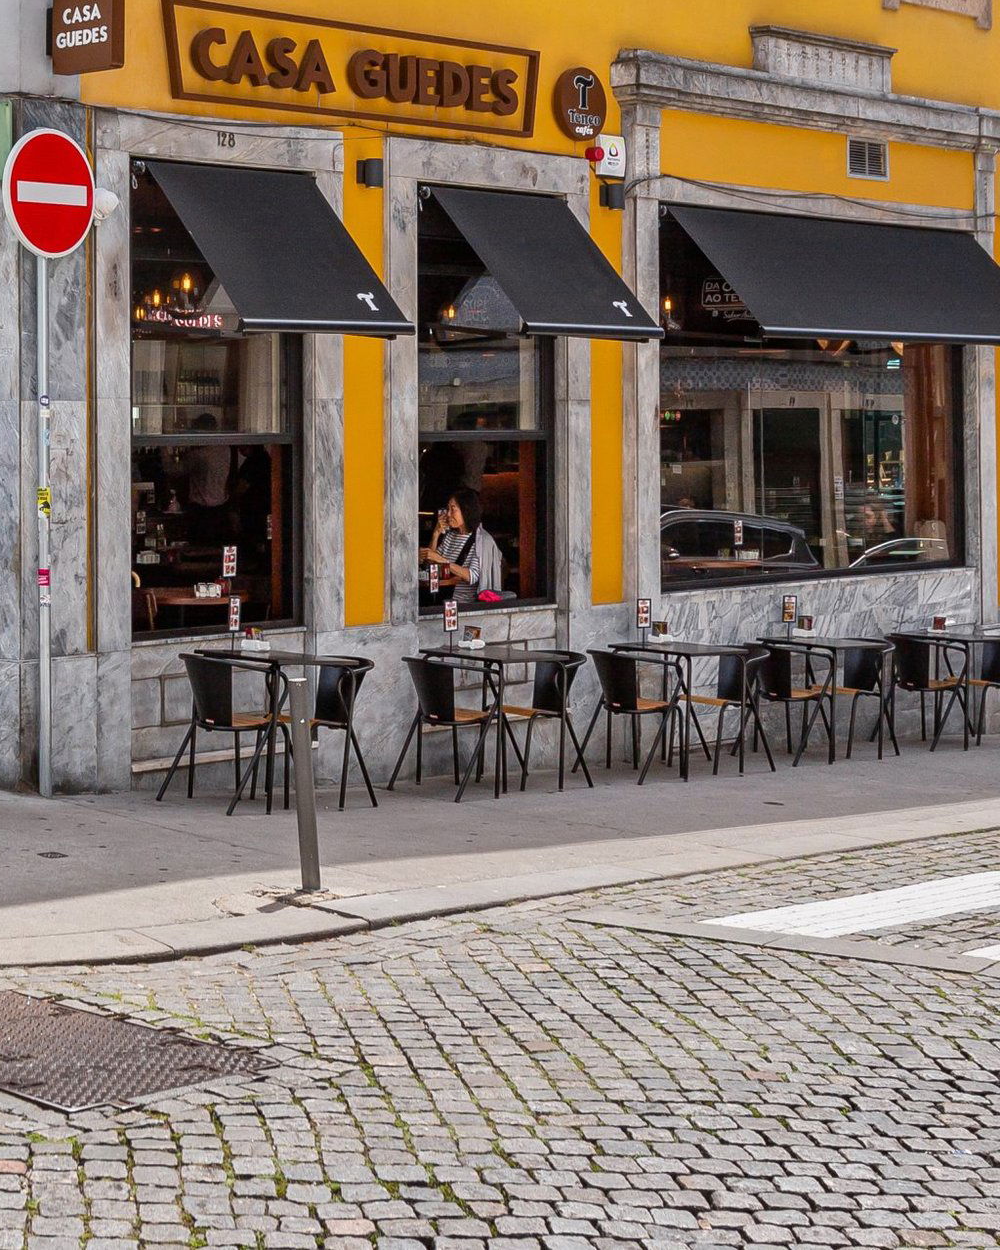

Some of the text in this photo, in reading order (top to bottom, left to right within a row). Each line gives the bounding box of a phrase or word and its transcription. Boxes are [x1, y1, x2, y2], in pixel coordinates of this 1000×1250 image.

[62, 3, 102, 25] CASA
[56, 25, 108, 49] GUEDES
[190, 27, 520, 116] CASA GUEDES
[574, 74, 595, 110] T
[568, 108, 602, 127] Tenco
[217, 130, 236, 148] 128
[705, 293, 721, 303] AO
